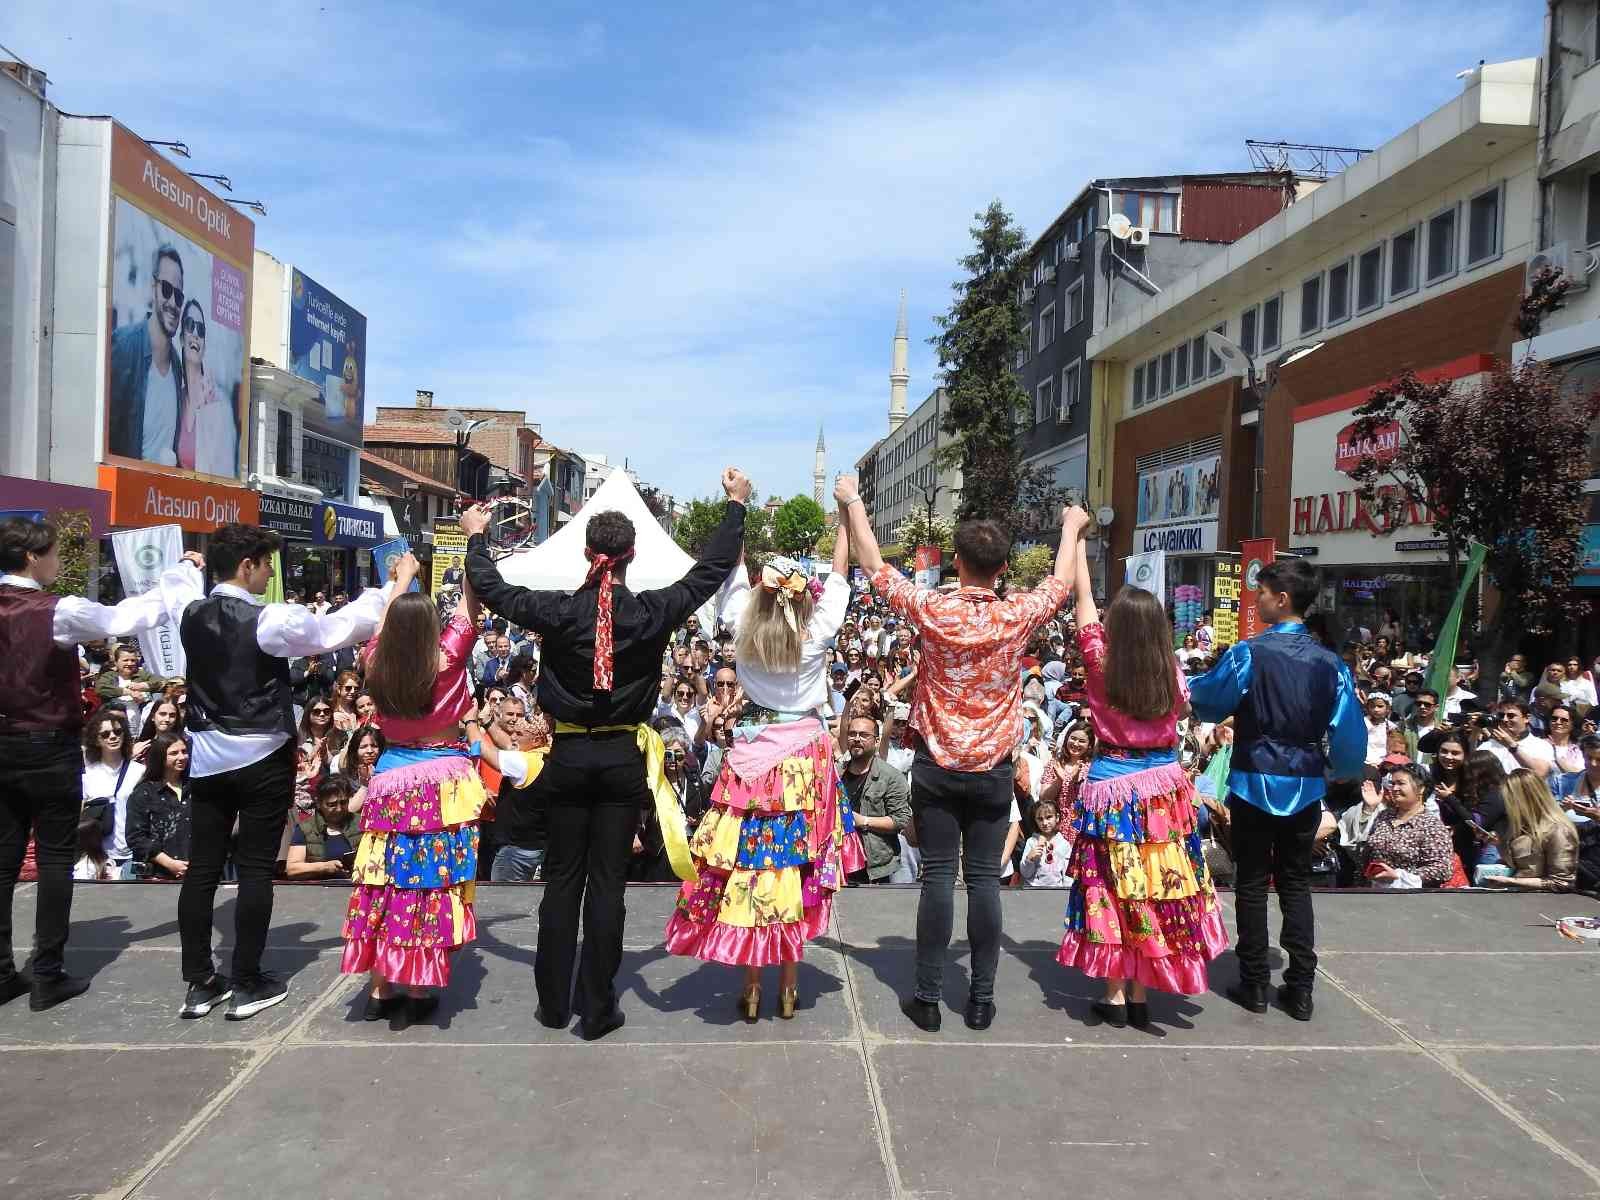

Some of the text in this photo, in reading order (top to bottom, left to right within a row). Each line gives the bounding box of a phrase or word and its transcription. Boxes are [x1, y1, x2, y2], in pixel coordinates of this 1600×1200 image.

[142, 159, 231, 240] Atasun Optik
[145, 486, 200, 520] Atasun
[204, 495, 240, 528] Optik
[338, 516, 377, 538] TURKCELL
